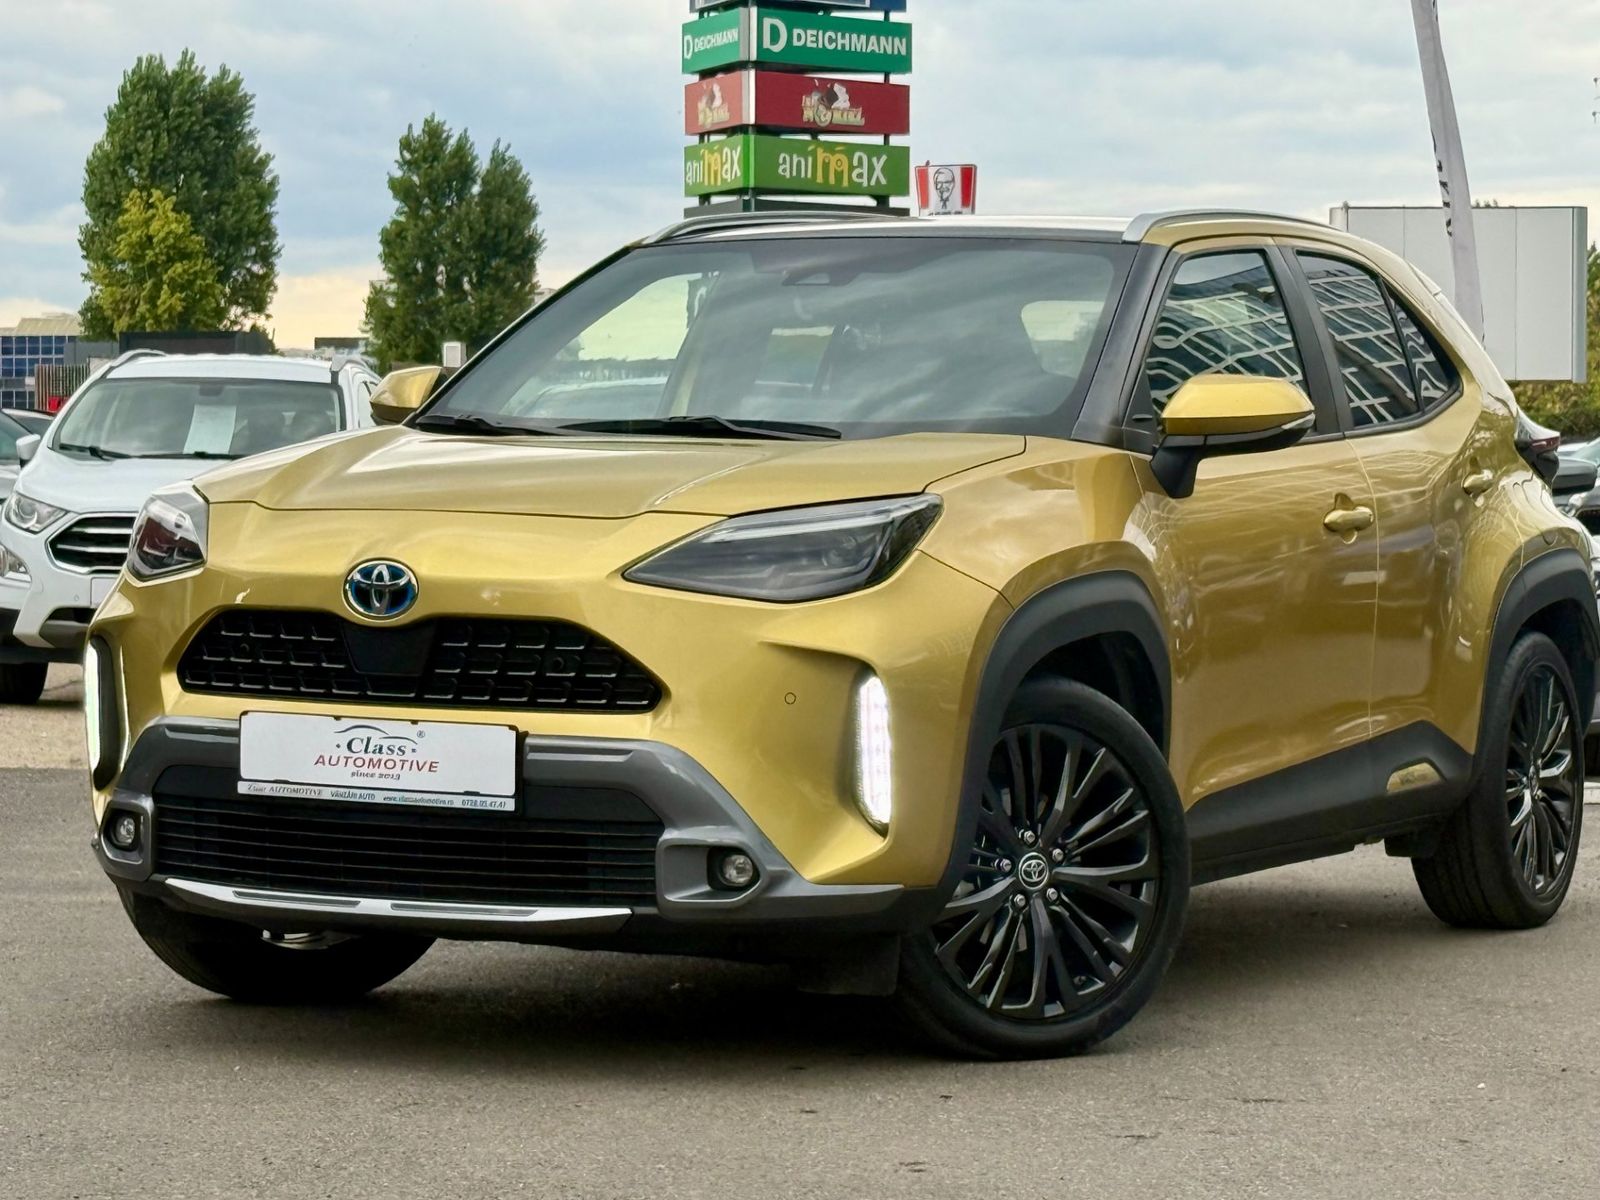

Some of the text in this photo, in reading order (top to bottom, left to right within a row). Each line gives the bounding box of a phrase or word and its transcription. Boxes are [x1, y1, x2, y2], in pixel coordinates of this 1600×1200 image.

[694, 28, 738, 51] DEICHMANN
[793, 28, 907, 56] DEICHMANN
[686, 145, 742, 186] animax
[778, 144, 888, 187] animax
[346, 736, 407, 756] Class
[314, 755, 440, 773] AUTOMOTIVE
[350, 770, 376, 778] since
